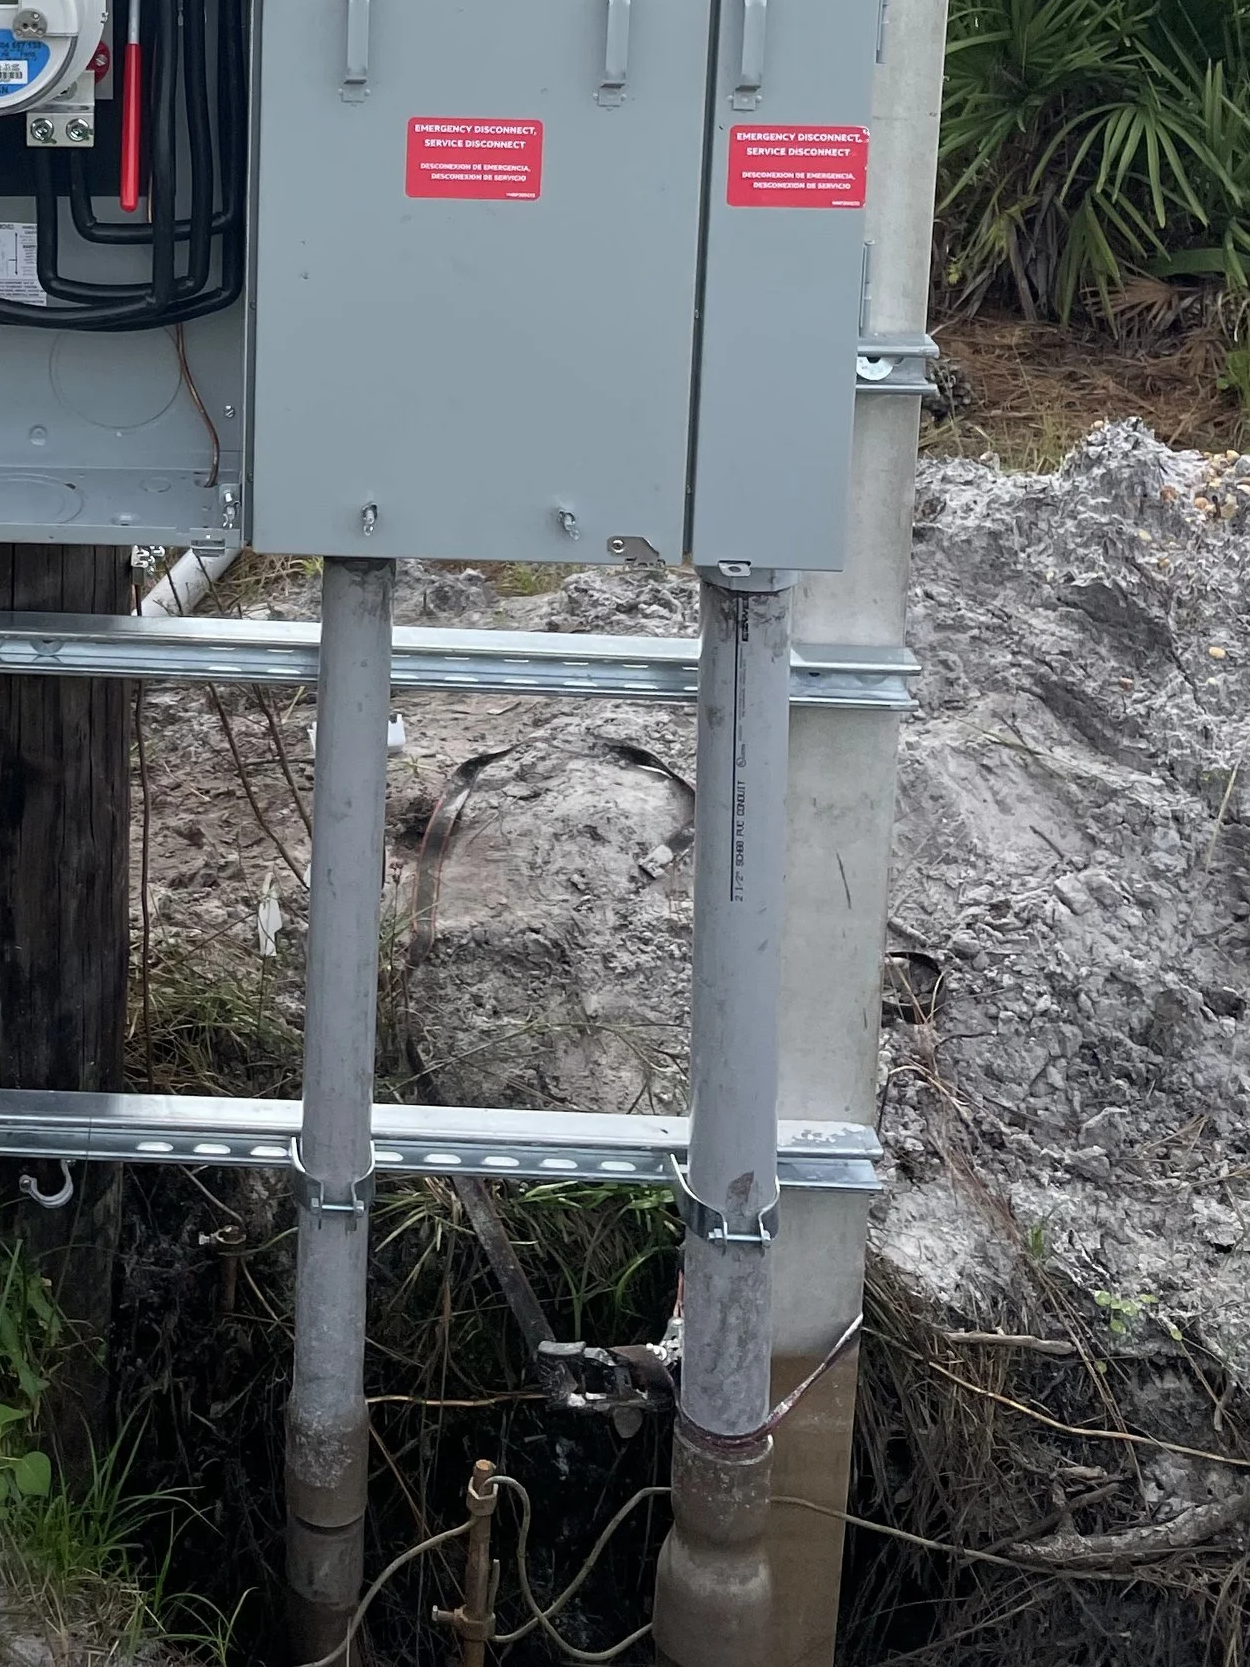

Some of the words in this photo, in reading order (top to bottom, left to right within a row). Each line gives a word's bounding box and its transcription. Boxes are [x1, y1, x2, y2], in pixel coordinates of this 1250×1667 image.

[414, 124, 472, 134] EMERGENCY
[474, 125, 537, 136] DISCONNECT,
[736, 132, 796, 141] EMERGENCY
[424, 138, 463, 148] SERVICE
[465, 140, 526, 149] DISCONNECT
[746, 147, 786, 156] SERVICE
[788, 148, 851, 157] DISCONNECT
[472, 163, 482, 171] DE
[494, 174, 527, 182] SERVICIO
[795, 171, 805, 179] DE
[817, 182, 852, 190] SERVICIO
[736, 780, 746, 816] CONDUIT
[736, 820, 745, 837] PVC
[734, 895, 744, 903] 2
